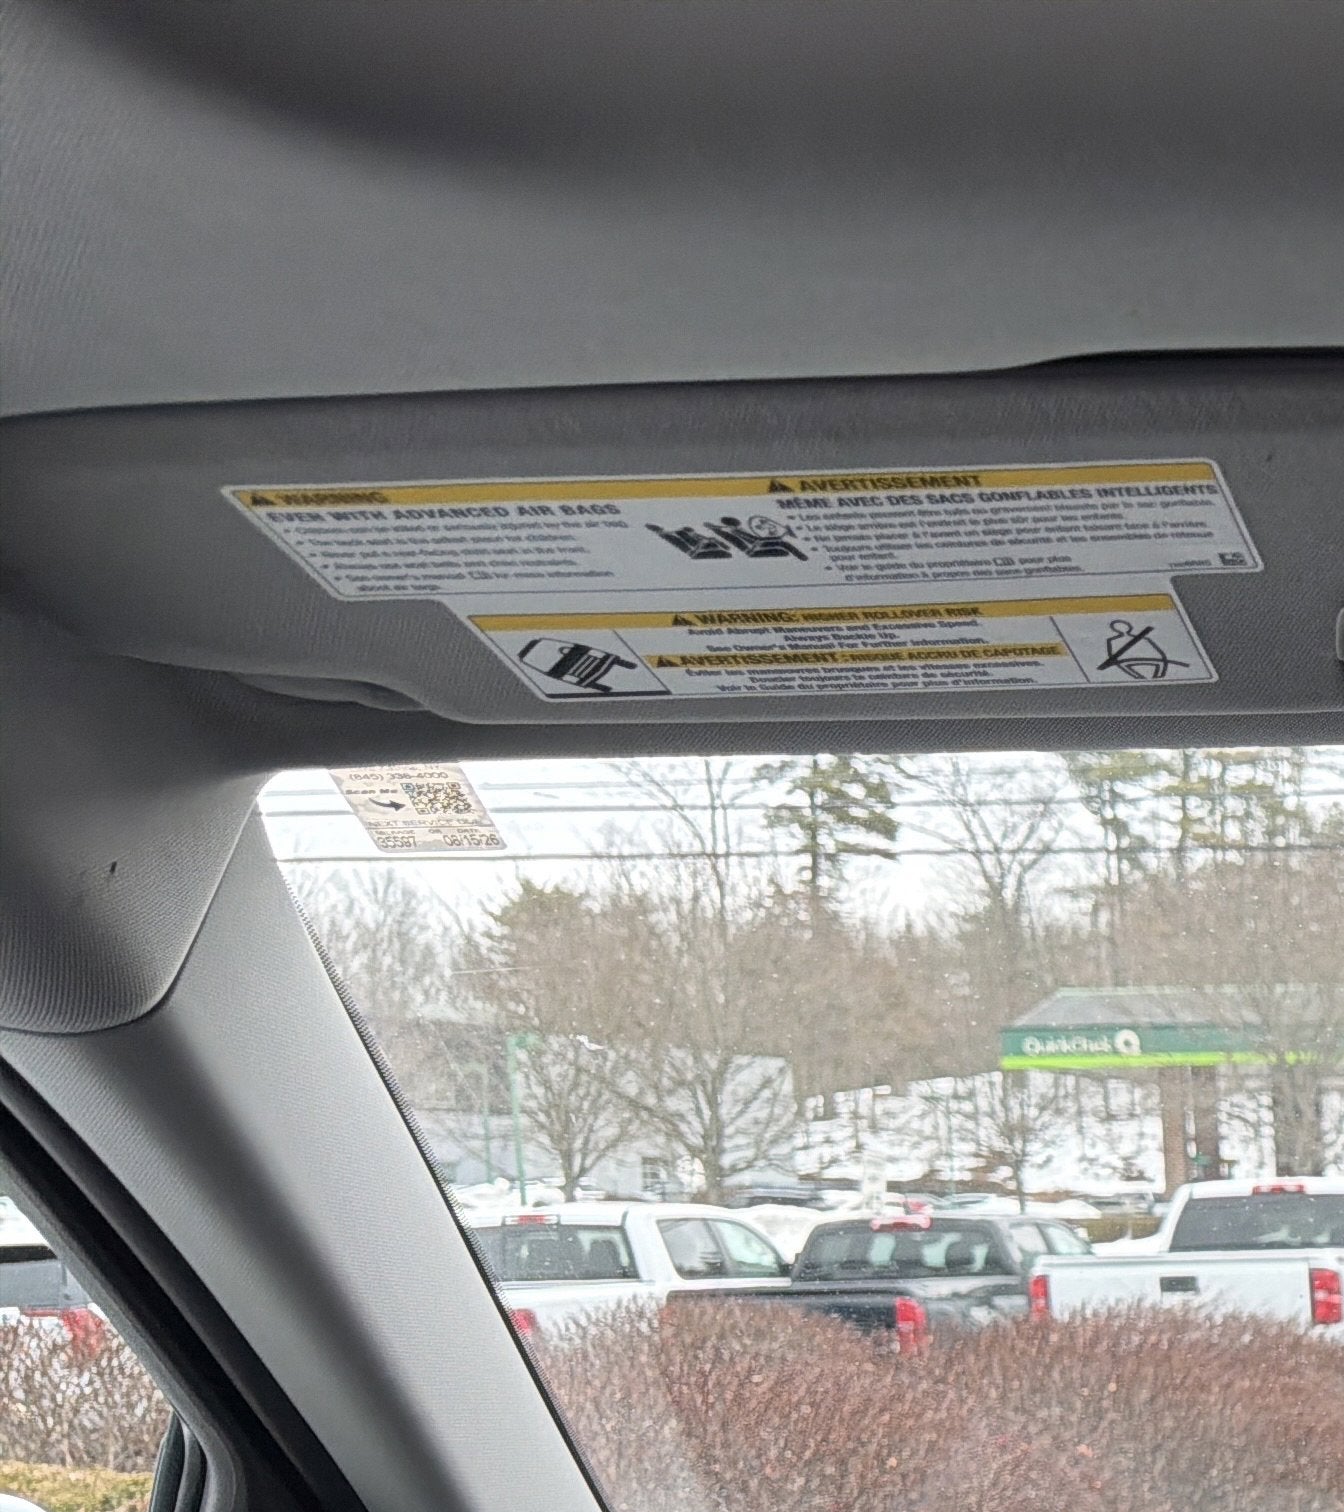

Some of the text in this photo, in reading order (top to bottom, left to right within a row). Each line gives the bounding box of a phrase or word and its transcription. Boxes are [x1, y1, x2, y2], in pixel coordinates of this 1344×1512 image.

[800, 475, 981, 492] AVERTISSEMENT
[837, 495, 885, 507] AVEC
[886, 494, 923, 506] DES
[925, 493, 975, 505] SACS
[978, 489, 1093, 502] GONFLABLES
[1096, 485, 1219, 498] INTELLIGENTS
[266, 504, 622, 523] EVEN WITH ADVANCED AIR BAGS
[862, 608, 943, 620] ROLLOVER
[945, 607, 982, 617] RISK
[727, 627, 771, 636] Abrupt
[846, 623, 870, 631] and
[783, 634, 830, 643] Always
[679, 652, 836, 666] AVERTISSEMENT
[982, 646, 1060, 659] CAPOTAGE
